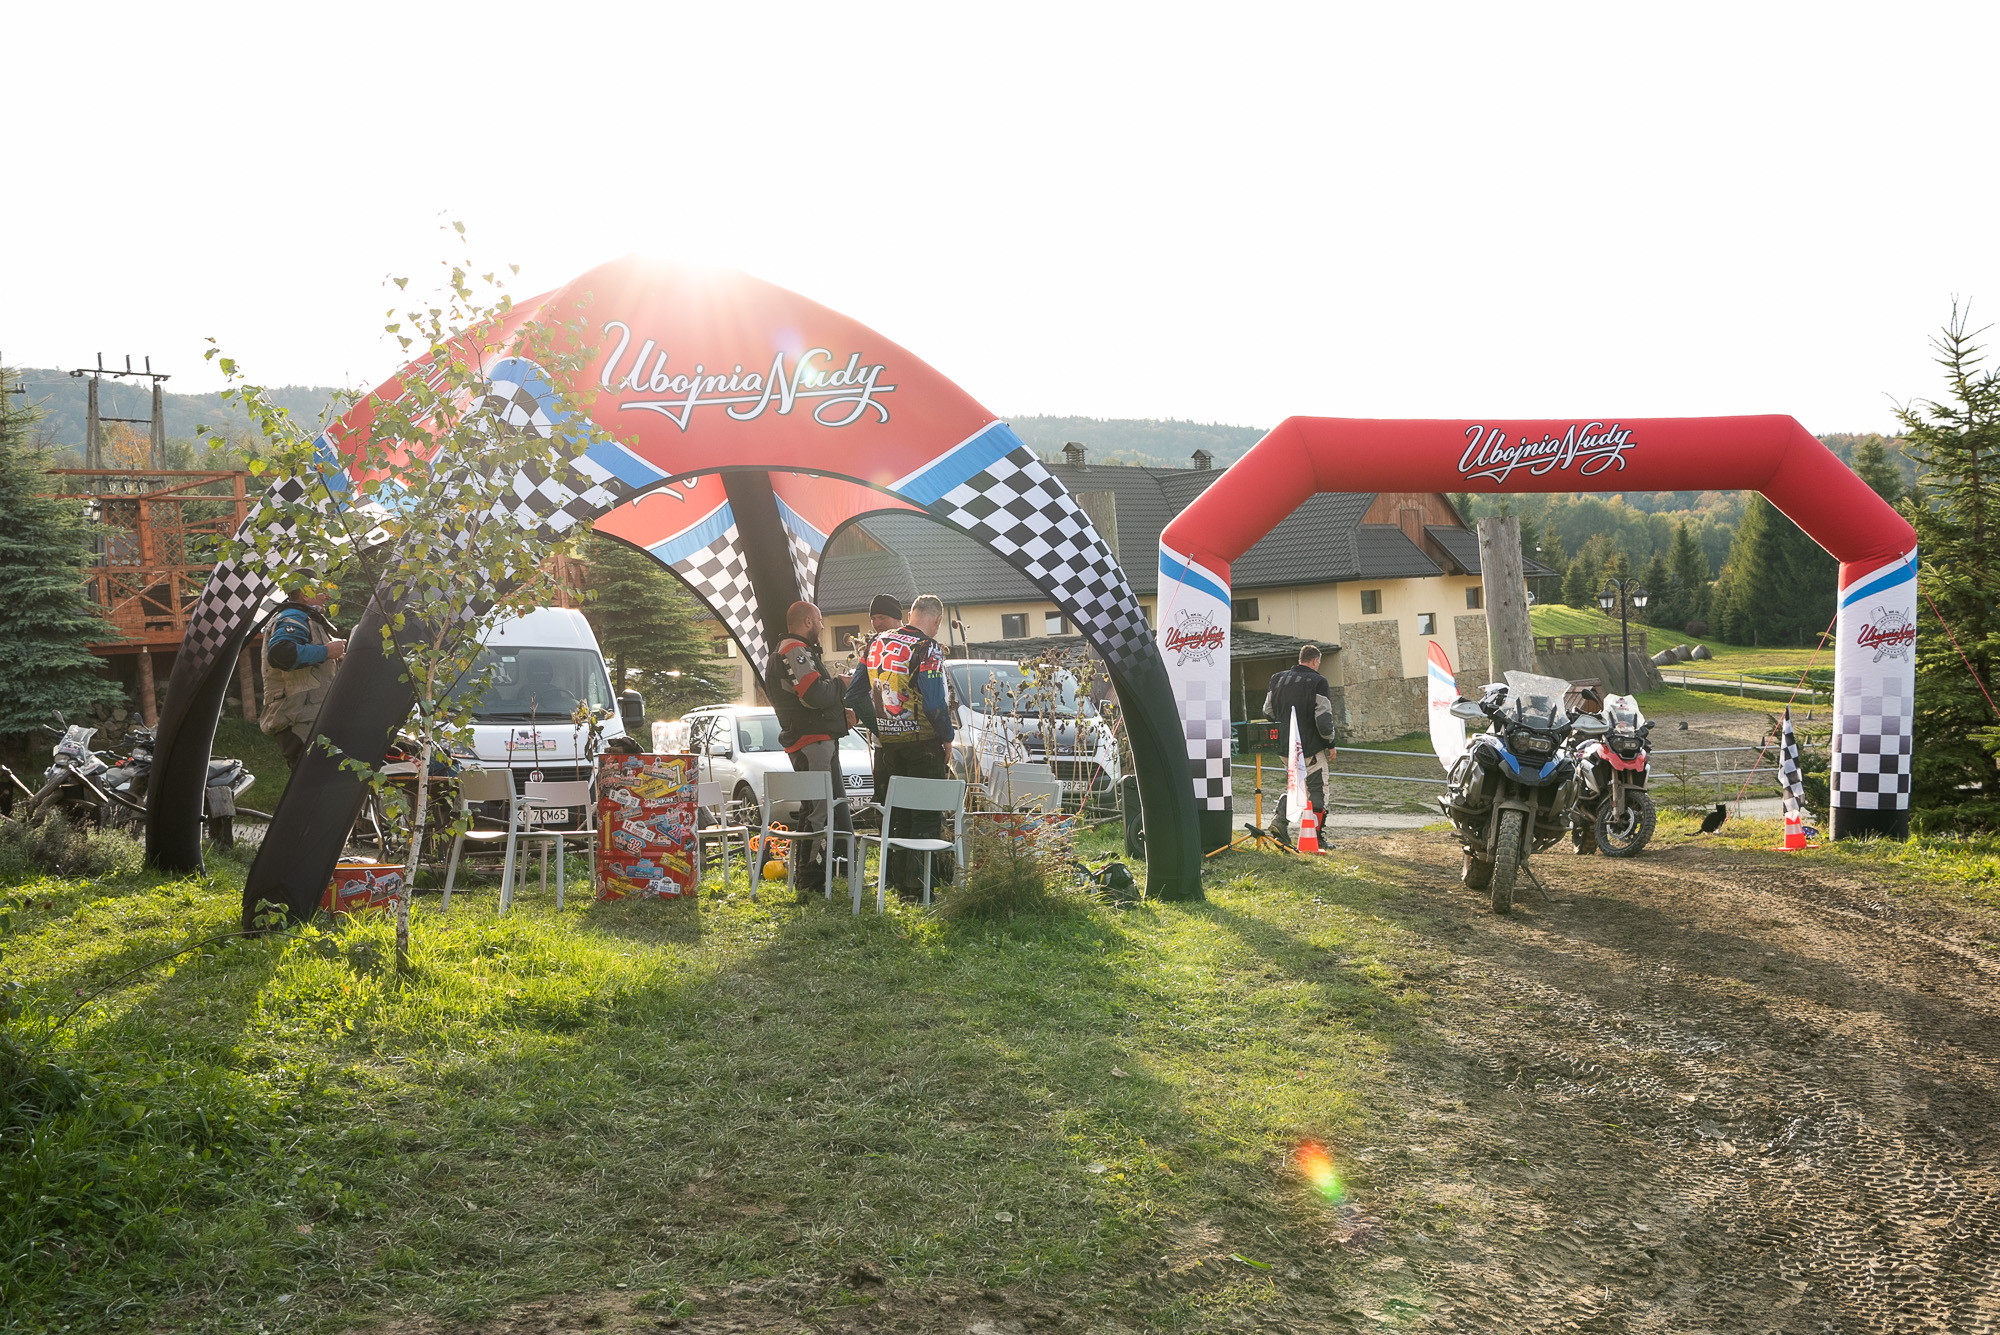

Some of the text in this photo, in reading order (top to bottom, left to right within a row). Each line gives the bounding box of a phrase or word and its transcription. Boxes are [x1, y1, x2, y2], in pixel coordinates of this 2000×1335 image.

[600, 321, 896, 432] Ubojnia Nudy
[1458, 422, 1636, 484] Ubojnia Nudy
[867, 639, 913, 675] 32
